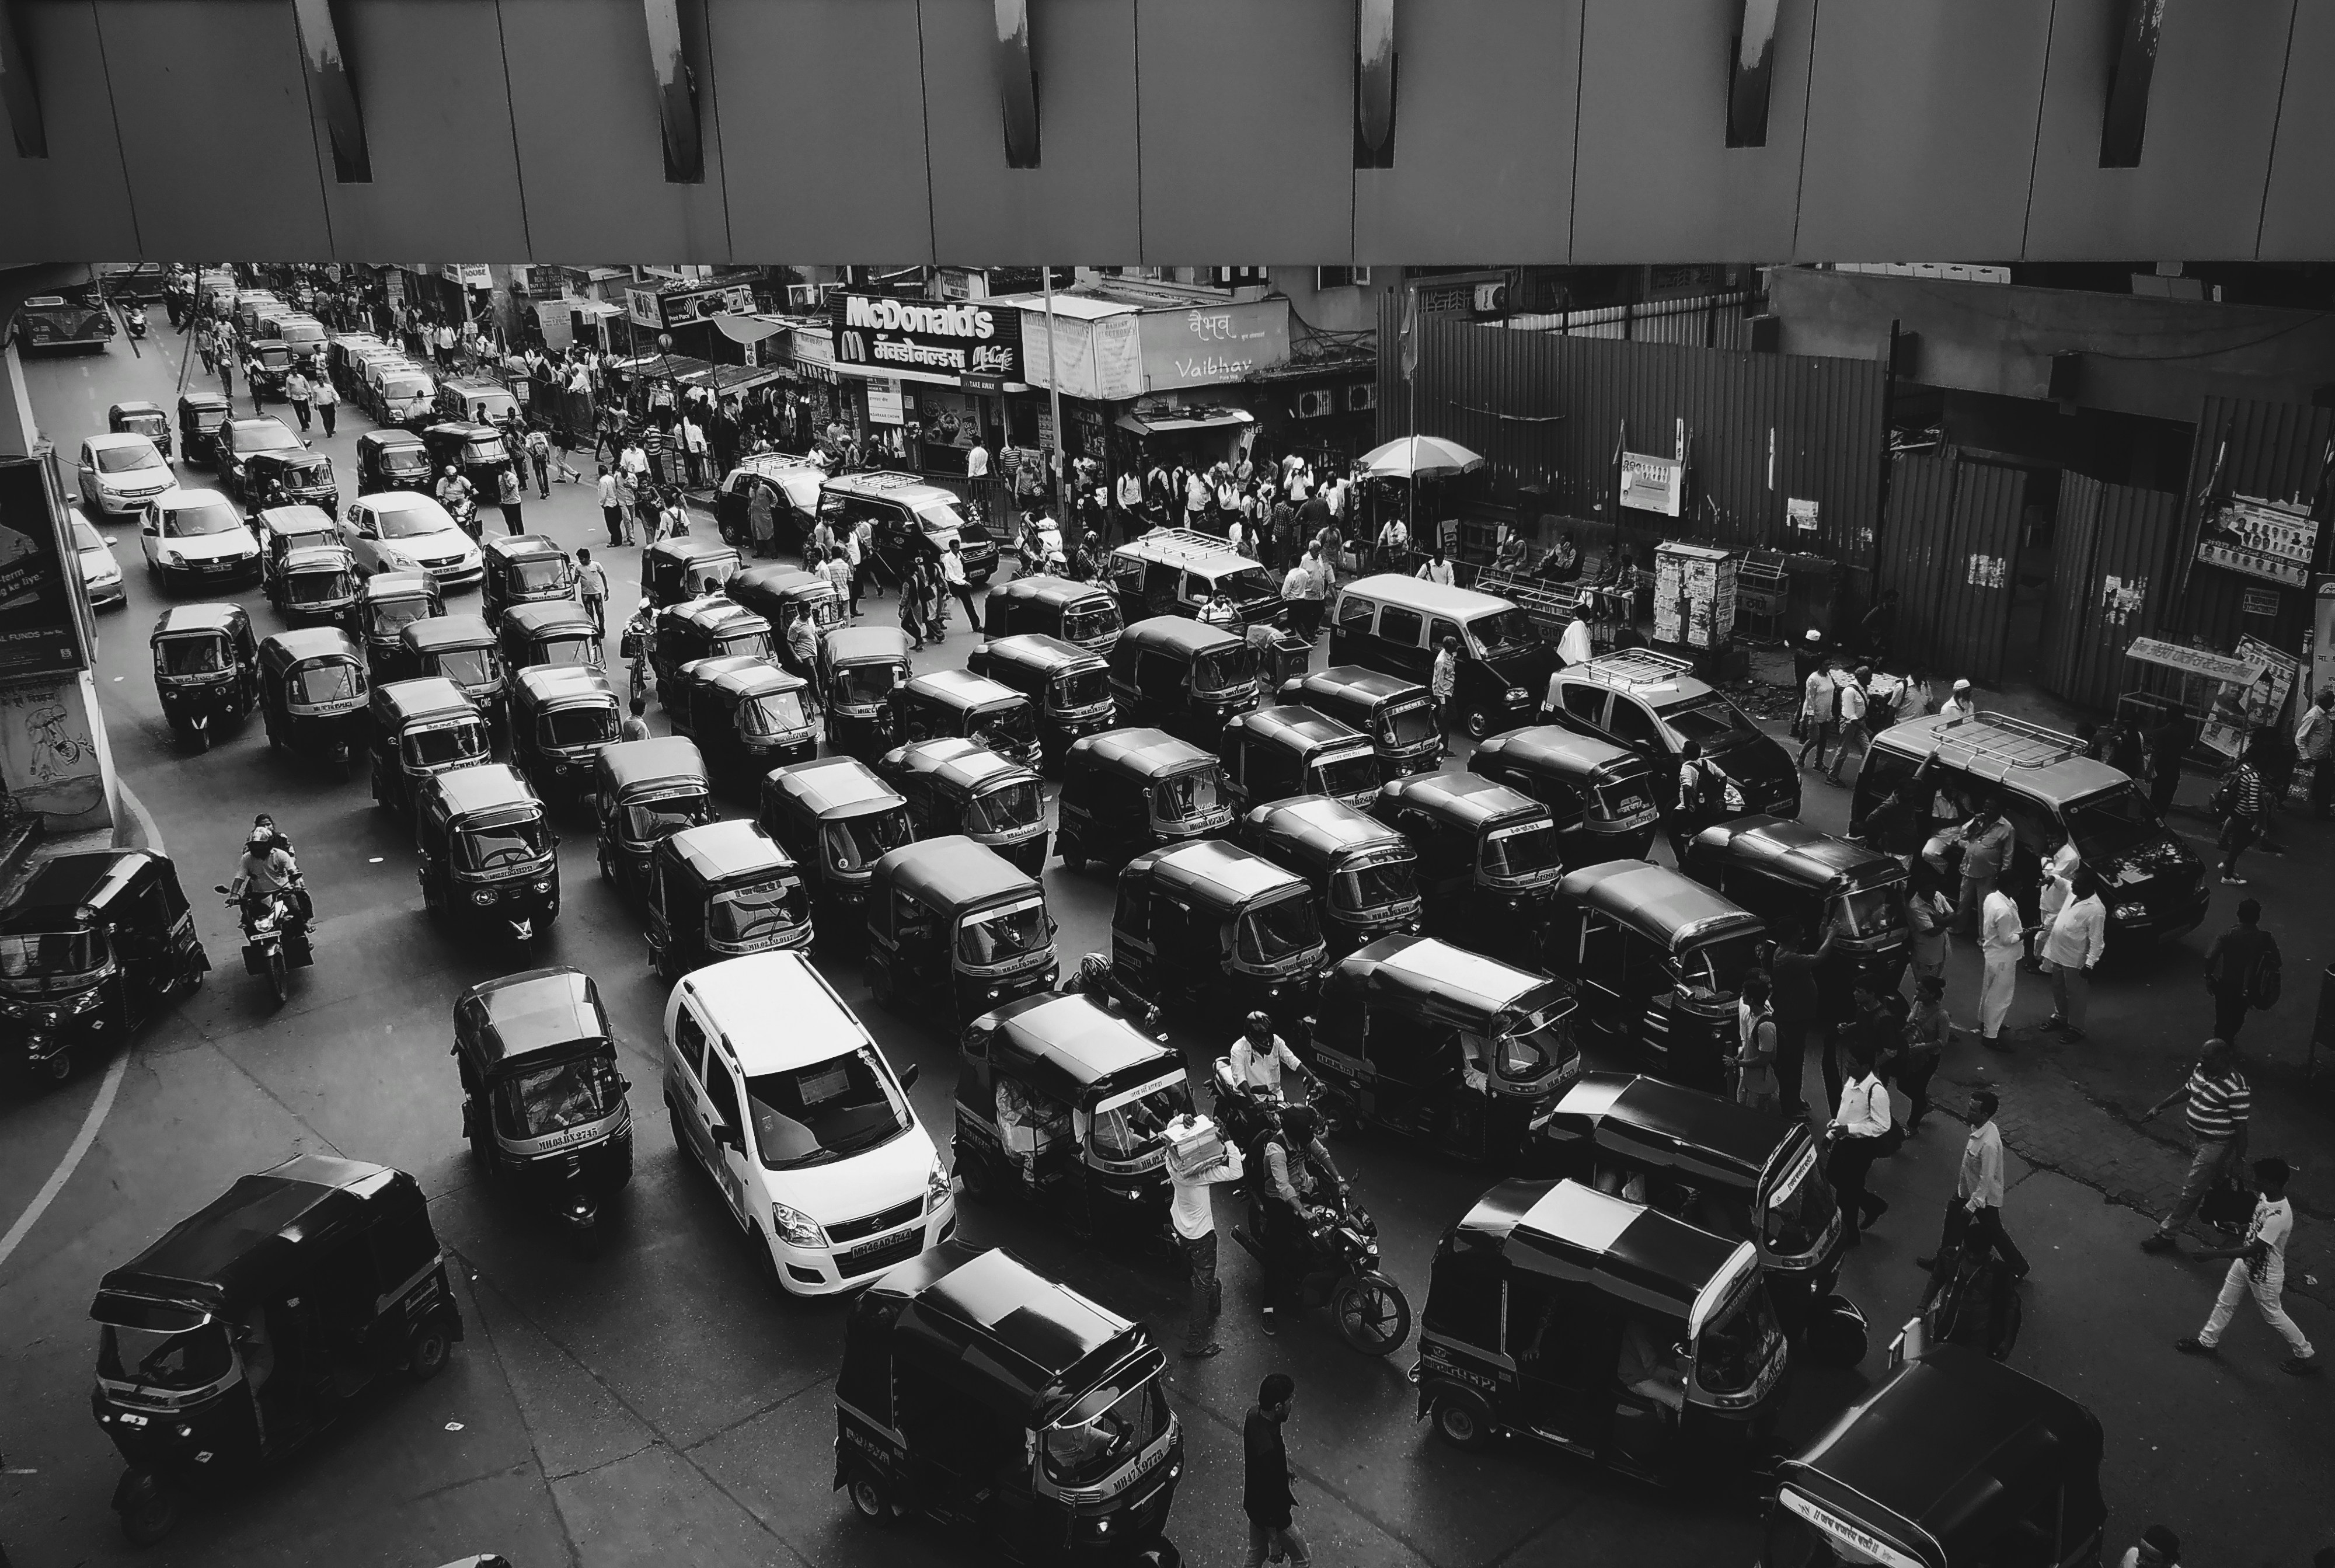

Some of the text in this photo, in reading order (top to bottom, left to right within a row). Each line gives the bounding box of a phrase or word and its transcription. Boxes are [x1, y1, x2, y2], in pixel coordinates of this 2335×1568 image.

[846, 297, 994, 339] McDonald's
[1188, 310, 1236, 341] वैभव
[1175, 356, 1252, 378] Vaibhav
[970, 381, 981, 389] TAKE
[334, 611, 344, 620] CNG
[9, 631, 40, 641] FUNDS
[480, 697, 492, 708] CNG
[853, 1230, 911, 1257] MH46AD4744
